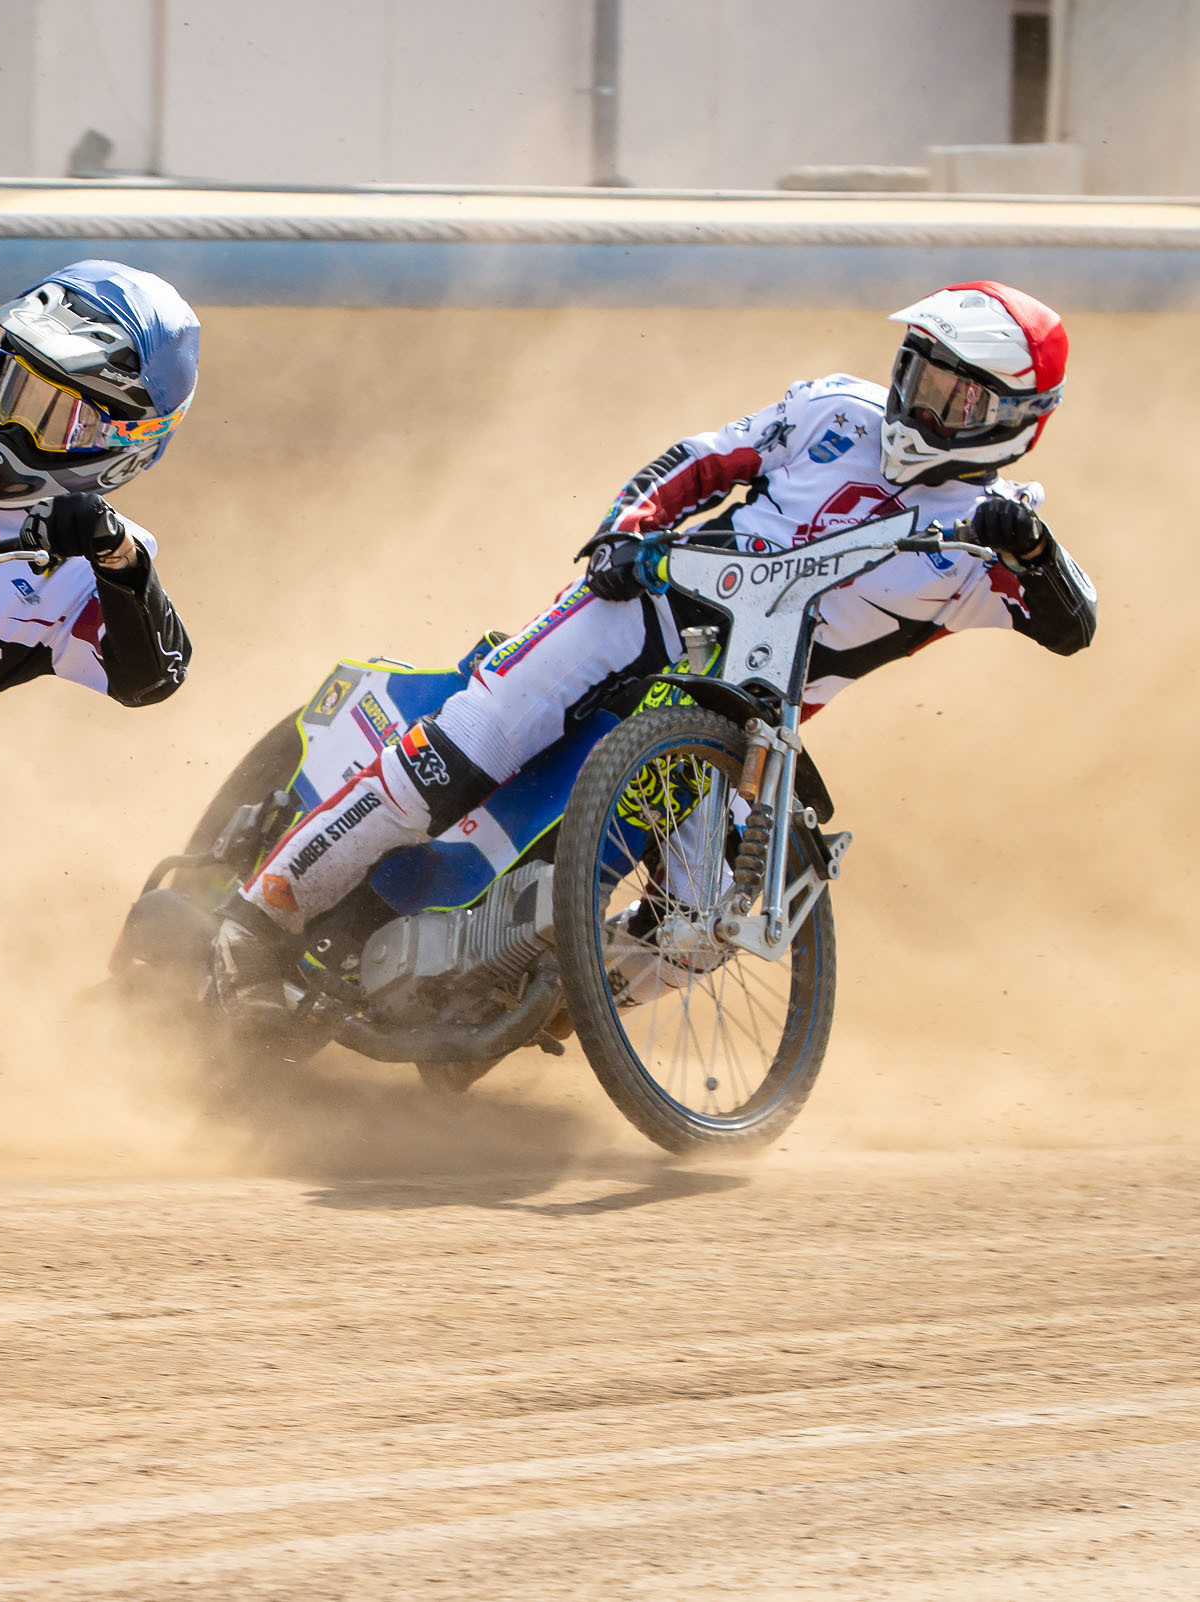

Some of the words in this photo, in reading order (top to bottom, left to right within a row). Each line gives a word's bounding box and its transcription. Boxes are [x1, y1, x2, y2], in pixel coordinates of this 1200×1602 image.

[750, 555, 844, 585] OPTIBET
[359, 693, 390, 732] CARPETS
[288, 833, 332, 880] AMBER
[325, 792, 382, 842] STUDIOS
